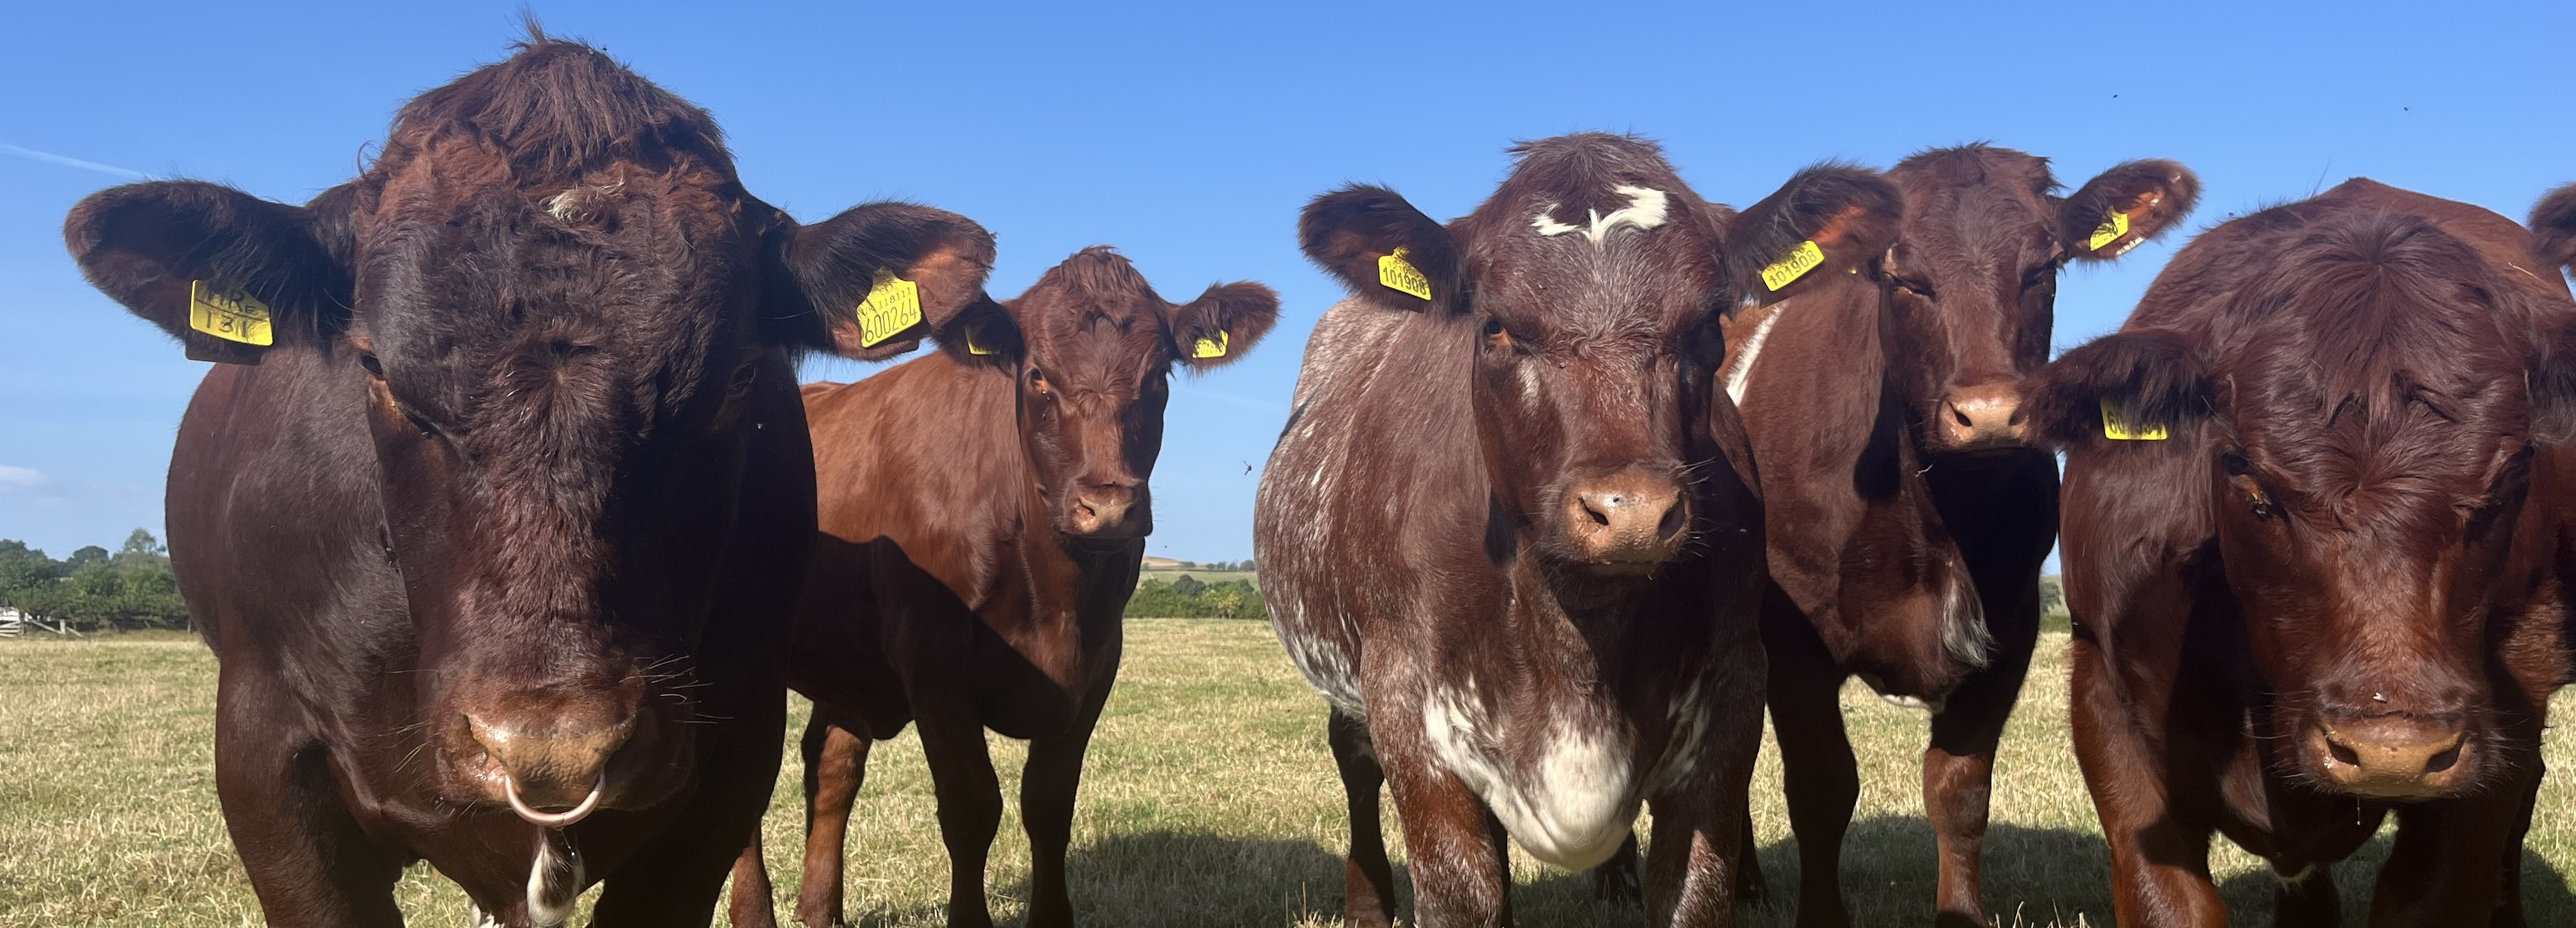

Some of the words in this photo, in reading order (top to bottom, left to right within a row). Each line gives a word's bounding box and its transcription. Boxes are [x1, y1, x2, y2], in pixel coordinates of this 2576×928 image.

[1383, 266, 1427, 295] 101908
[1769, 249, 1817, 286] 101908
[864, 297, 918, 343] 600264
